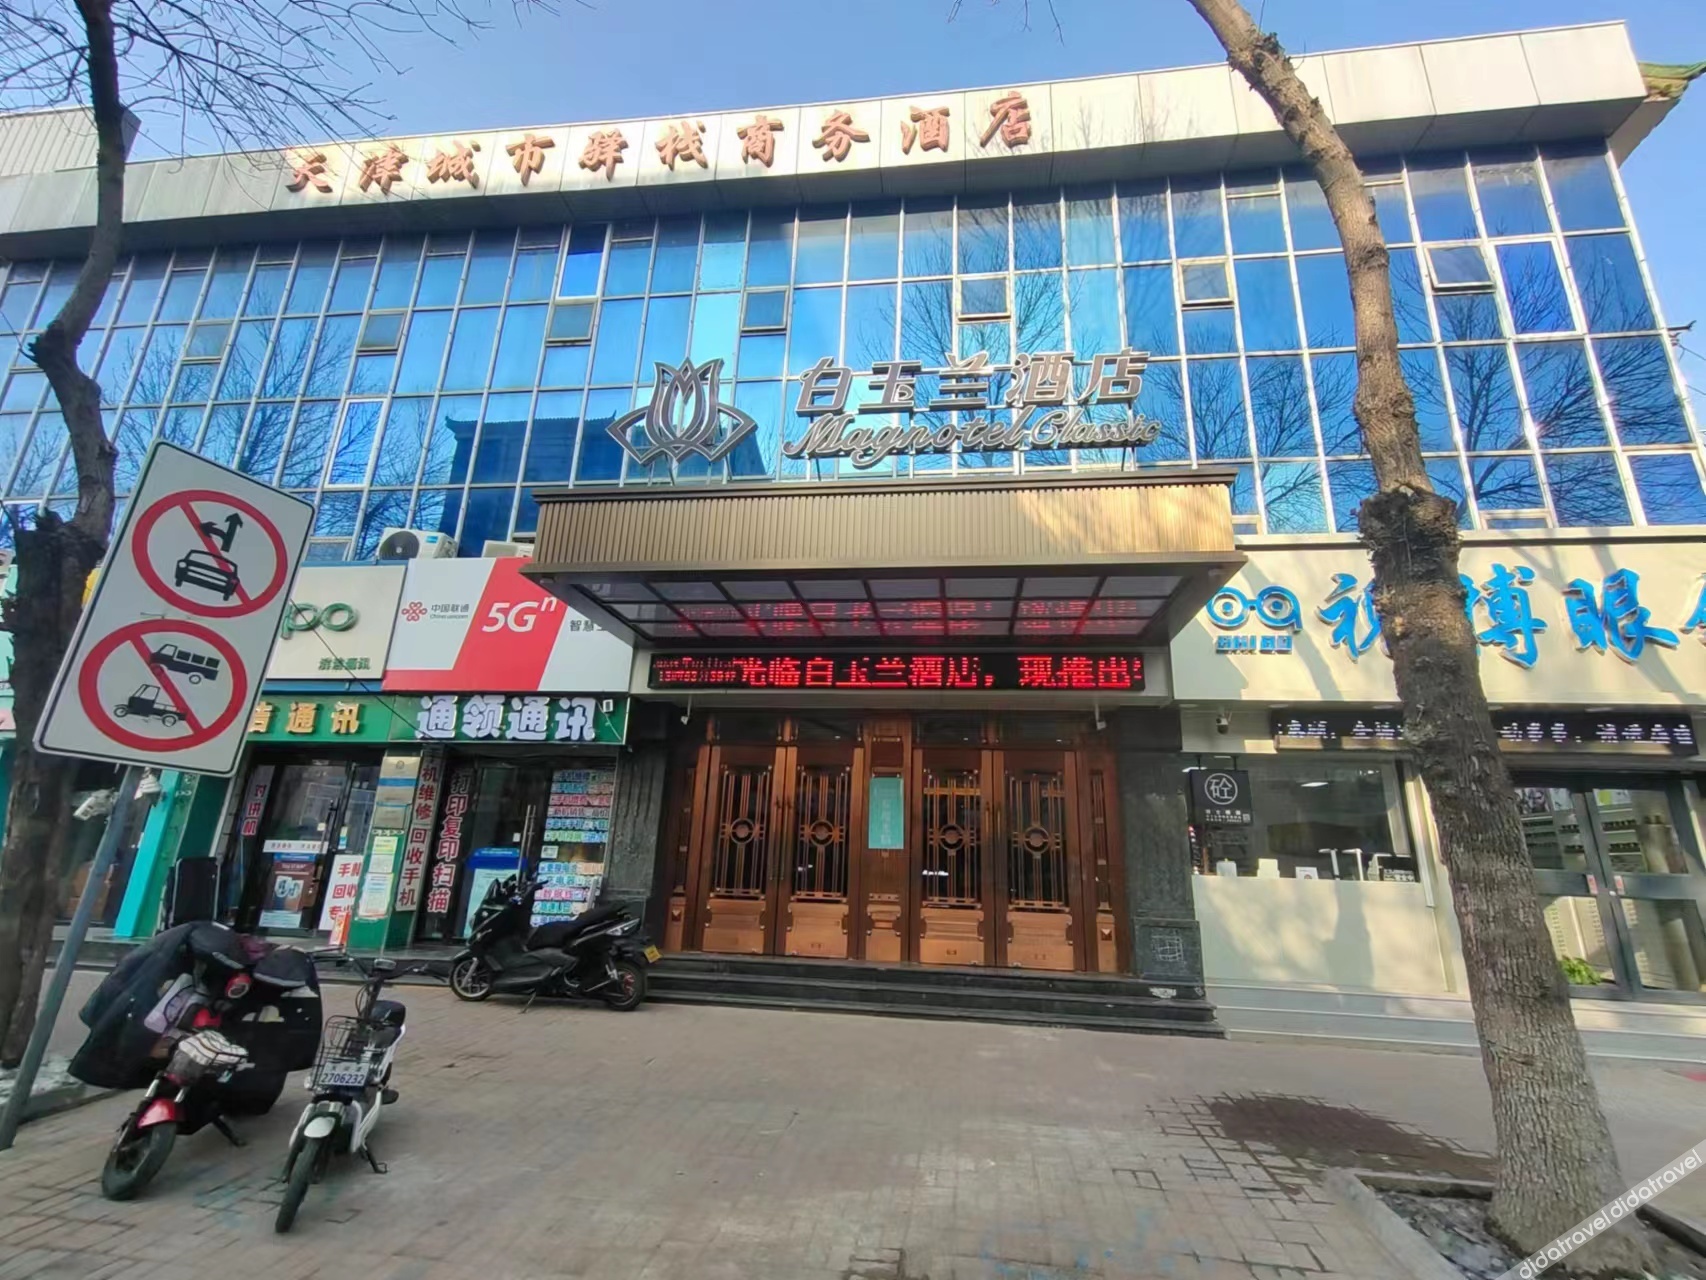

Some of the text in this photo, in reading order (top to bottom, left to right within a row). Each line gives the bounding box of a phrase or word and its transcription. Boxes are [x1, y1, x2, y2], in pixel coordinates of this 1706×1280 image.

[285, 90, 1034, 194] 天津城市驿栈商务酒店
[796, 350, 1151, 417] 白玉兰酒店
[784, 404, 1161, 469] Magnotel Classic
[431, 603, 469, 613] 中国联通
[416, 695, 596, 741] 通领通讯
[415, 762, 438, 820] 机维修
[399, 828, 428, 907] 回收手机
[427, 772, 473, 913] 打印复印扫描
